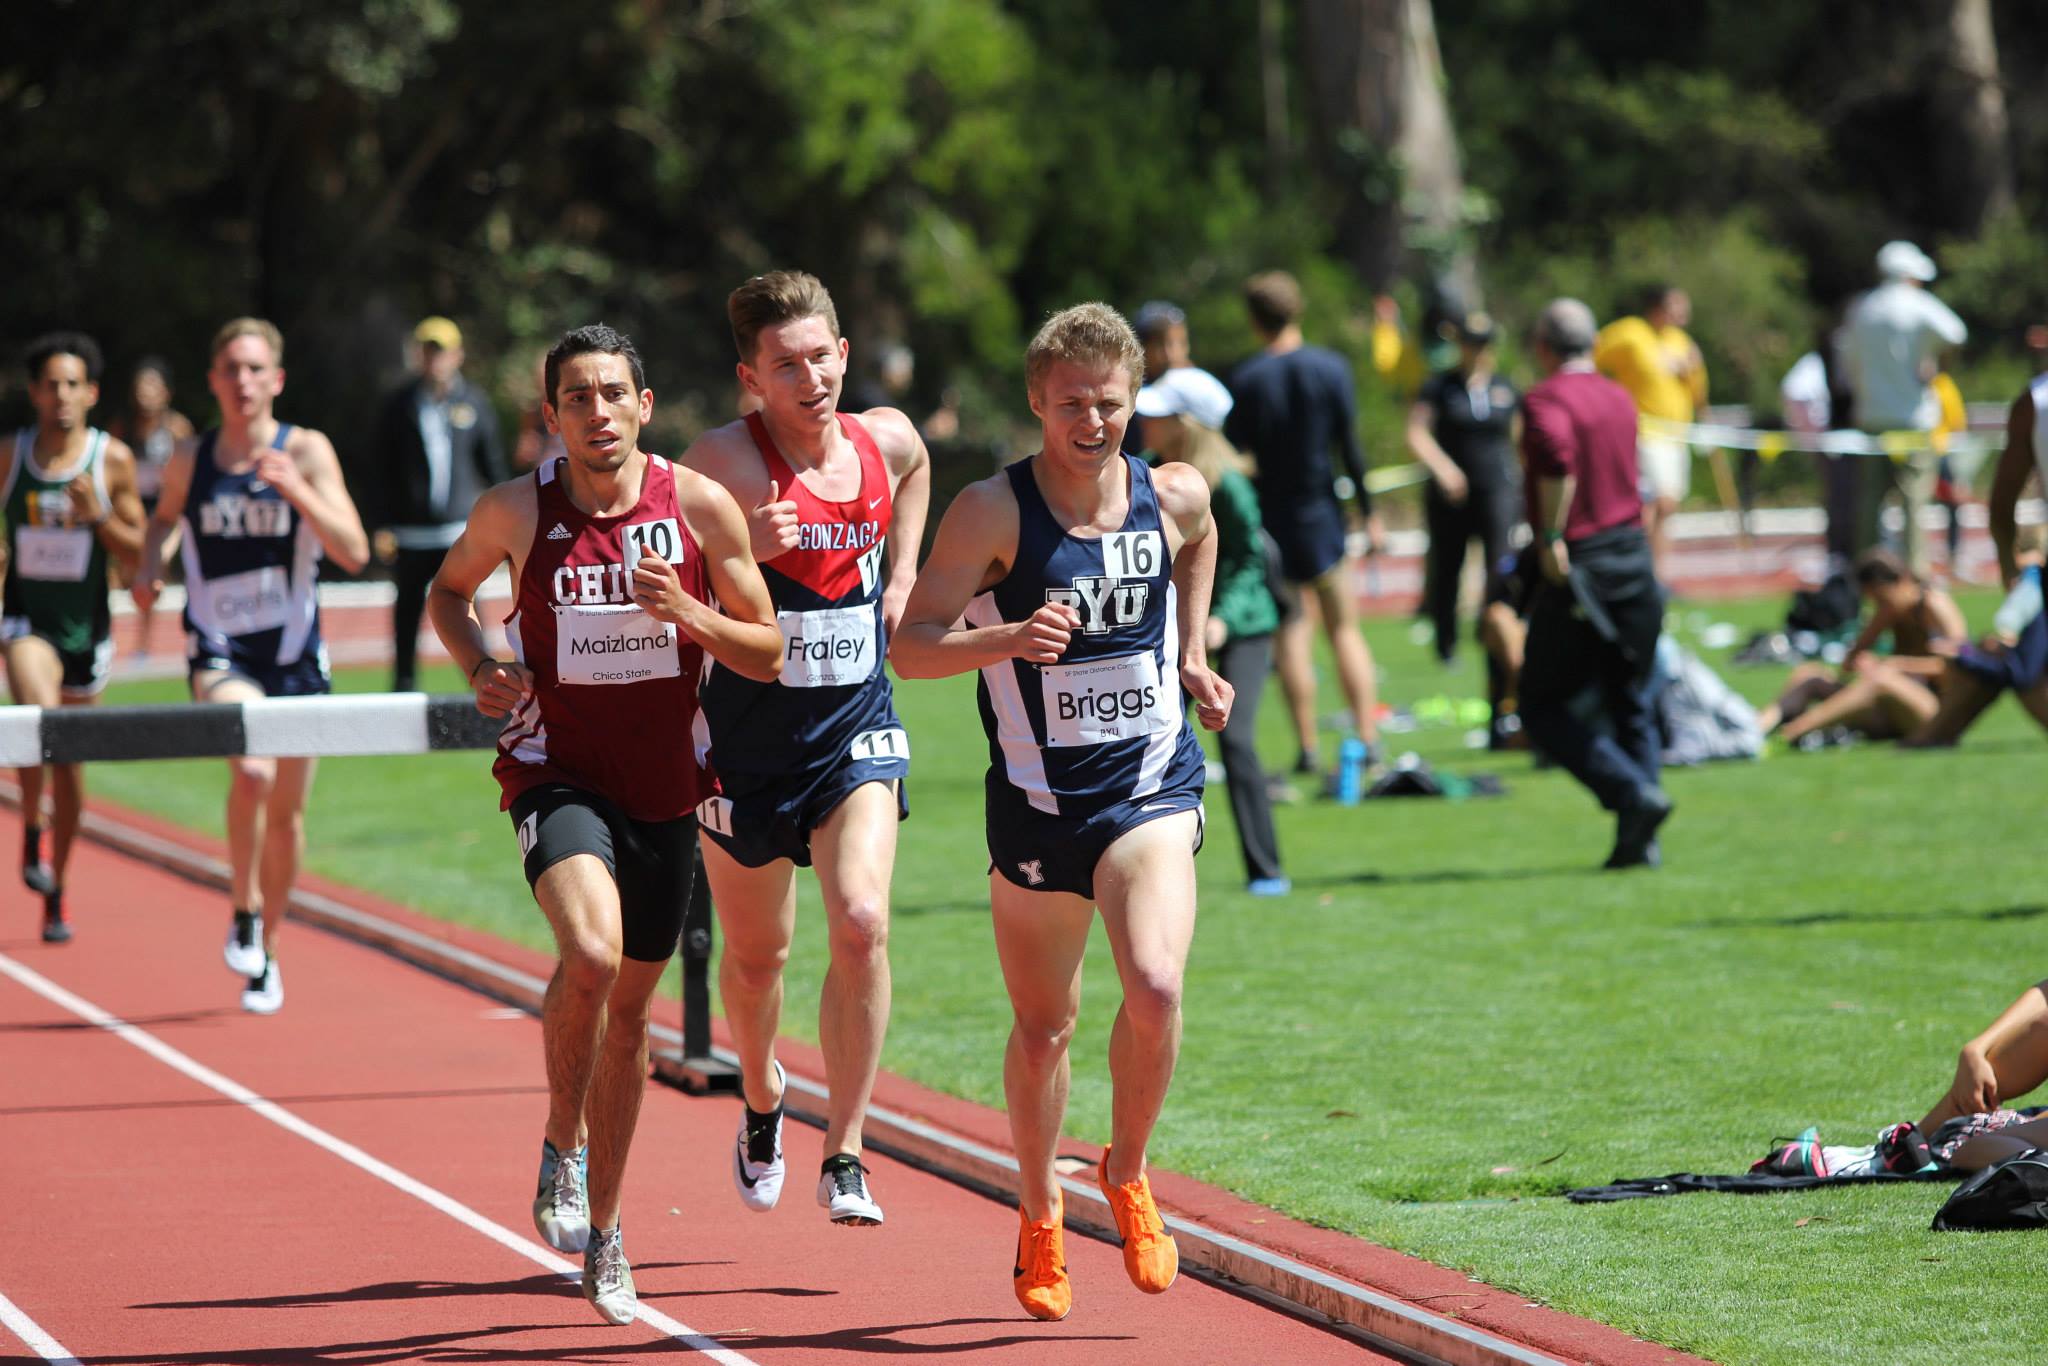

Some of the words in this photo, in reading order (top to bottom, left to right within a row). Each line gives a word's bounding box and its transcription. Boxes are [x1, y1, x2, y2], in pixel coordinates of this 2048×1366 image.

[547, 532, 573, 540] adidas
[631, 522, 672, 562] 10
[1112, 533, 1153, 575] 16
[1045, 576, 1149, 635] BYU
[571, 630, 669, 656] Maizland
[787, 633, 866, 663] Fraley
[592, 672, 623, 681] Chico
[625, 669, 652, 679] State
[806, 673, 846, 683] Gonzaga
[1089, 665, 1116, 674] Distance
[1057, 686, 1156, 723] Briggs
[860, 732, 895, 756] 11
[1100, 727, 1119, 737] BYU
